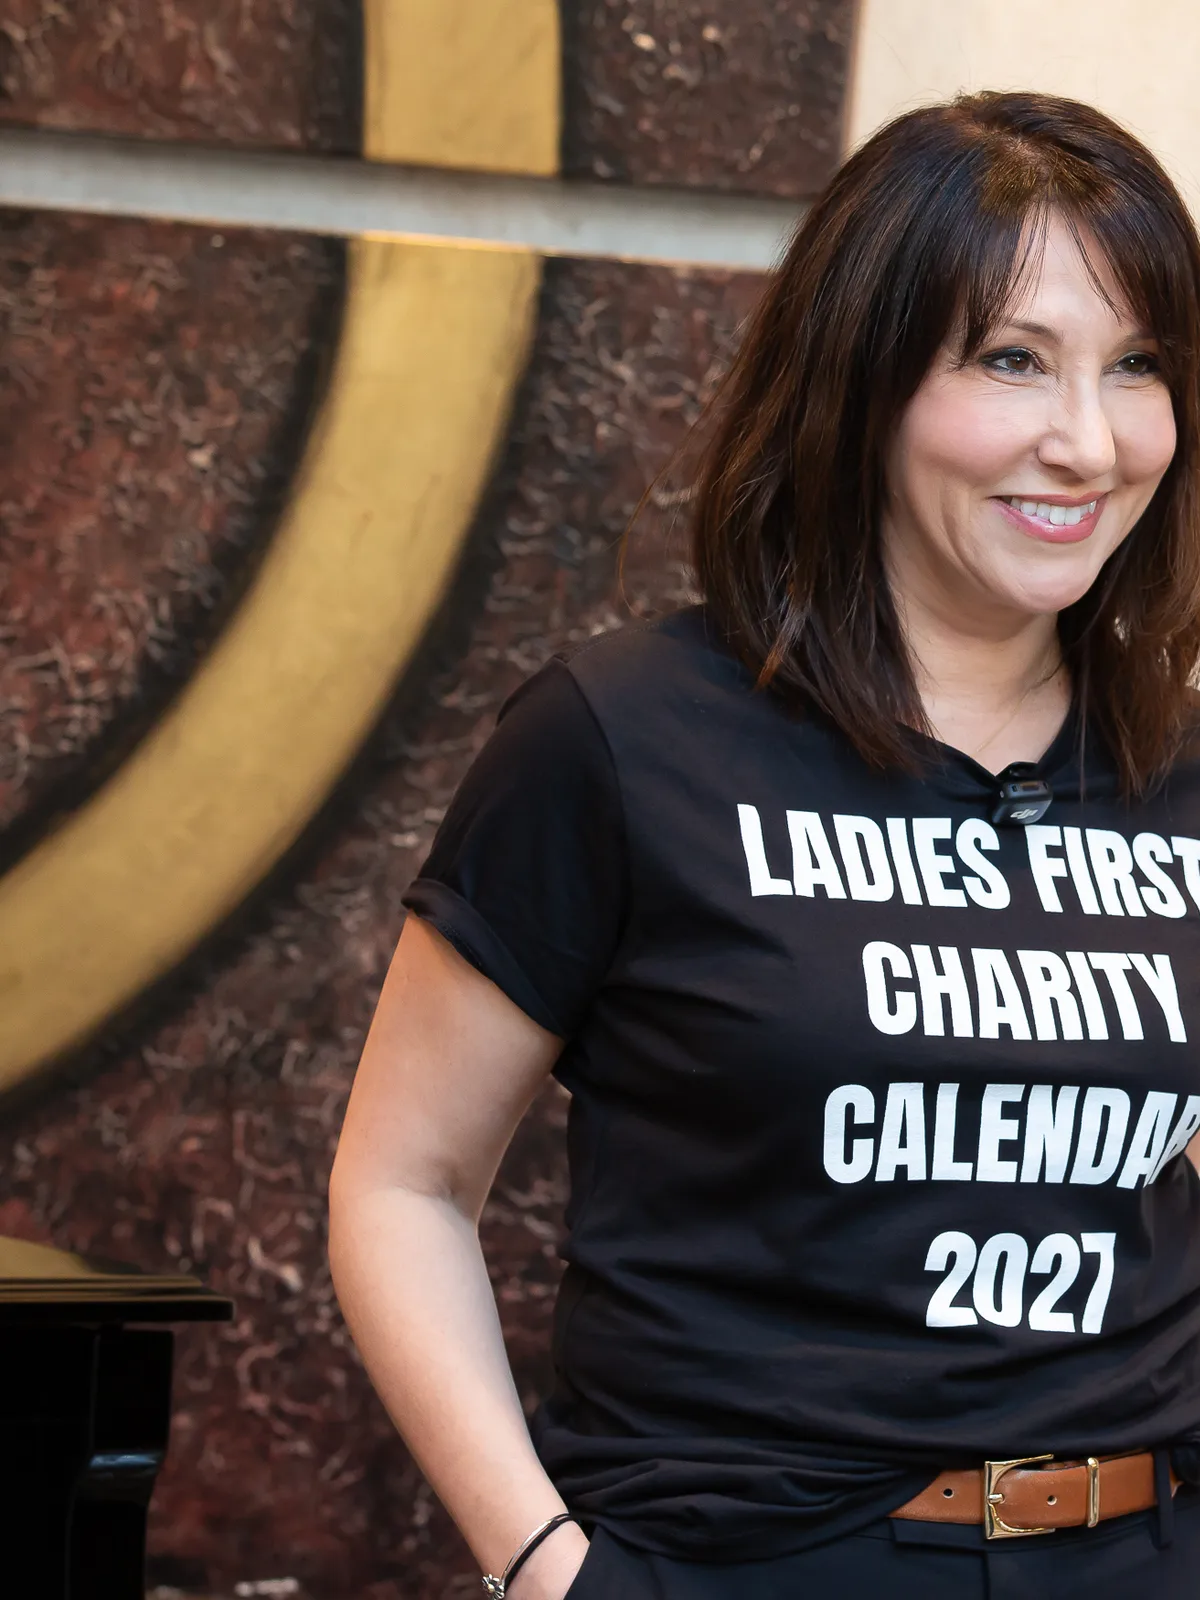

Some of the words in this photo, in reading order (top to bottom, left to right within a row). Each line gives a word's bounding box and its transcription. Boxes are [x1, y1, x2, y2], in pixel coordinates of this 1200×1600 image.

[737, 804, 1010, 910] LADIES
[862, 941, 1187, 1043] CHARITY
[924, 1231, 1116, 1334] 2027
